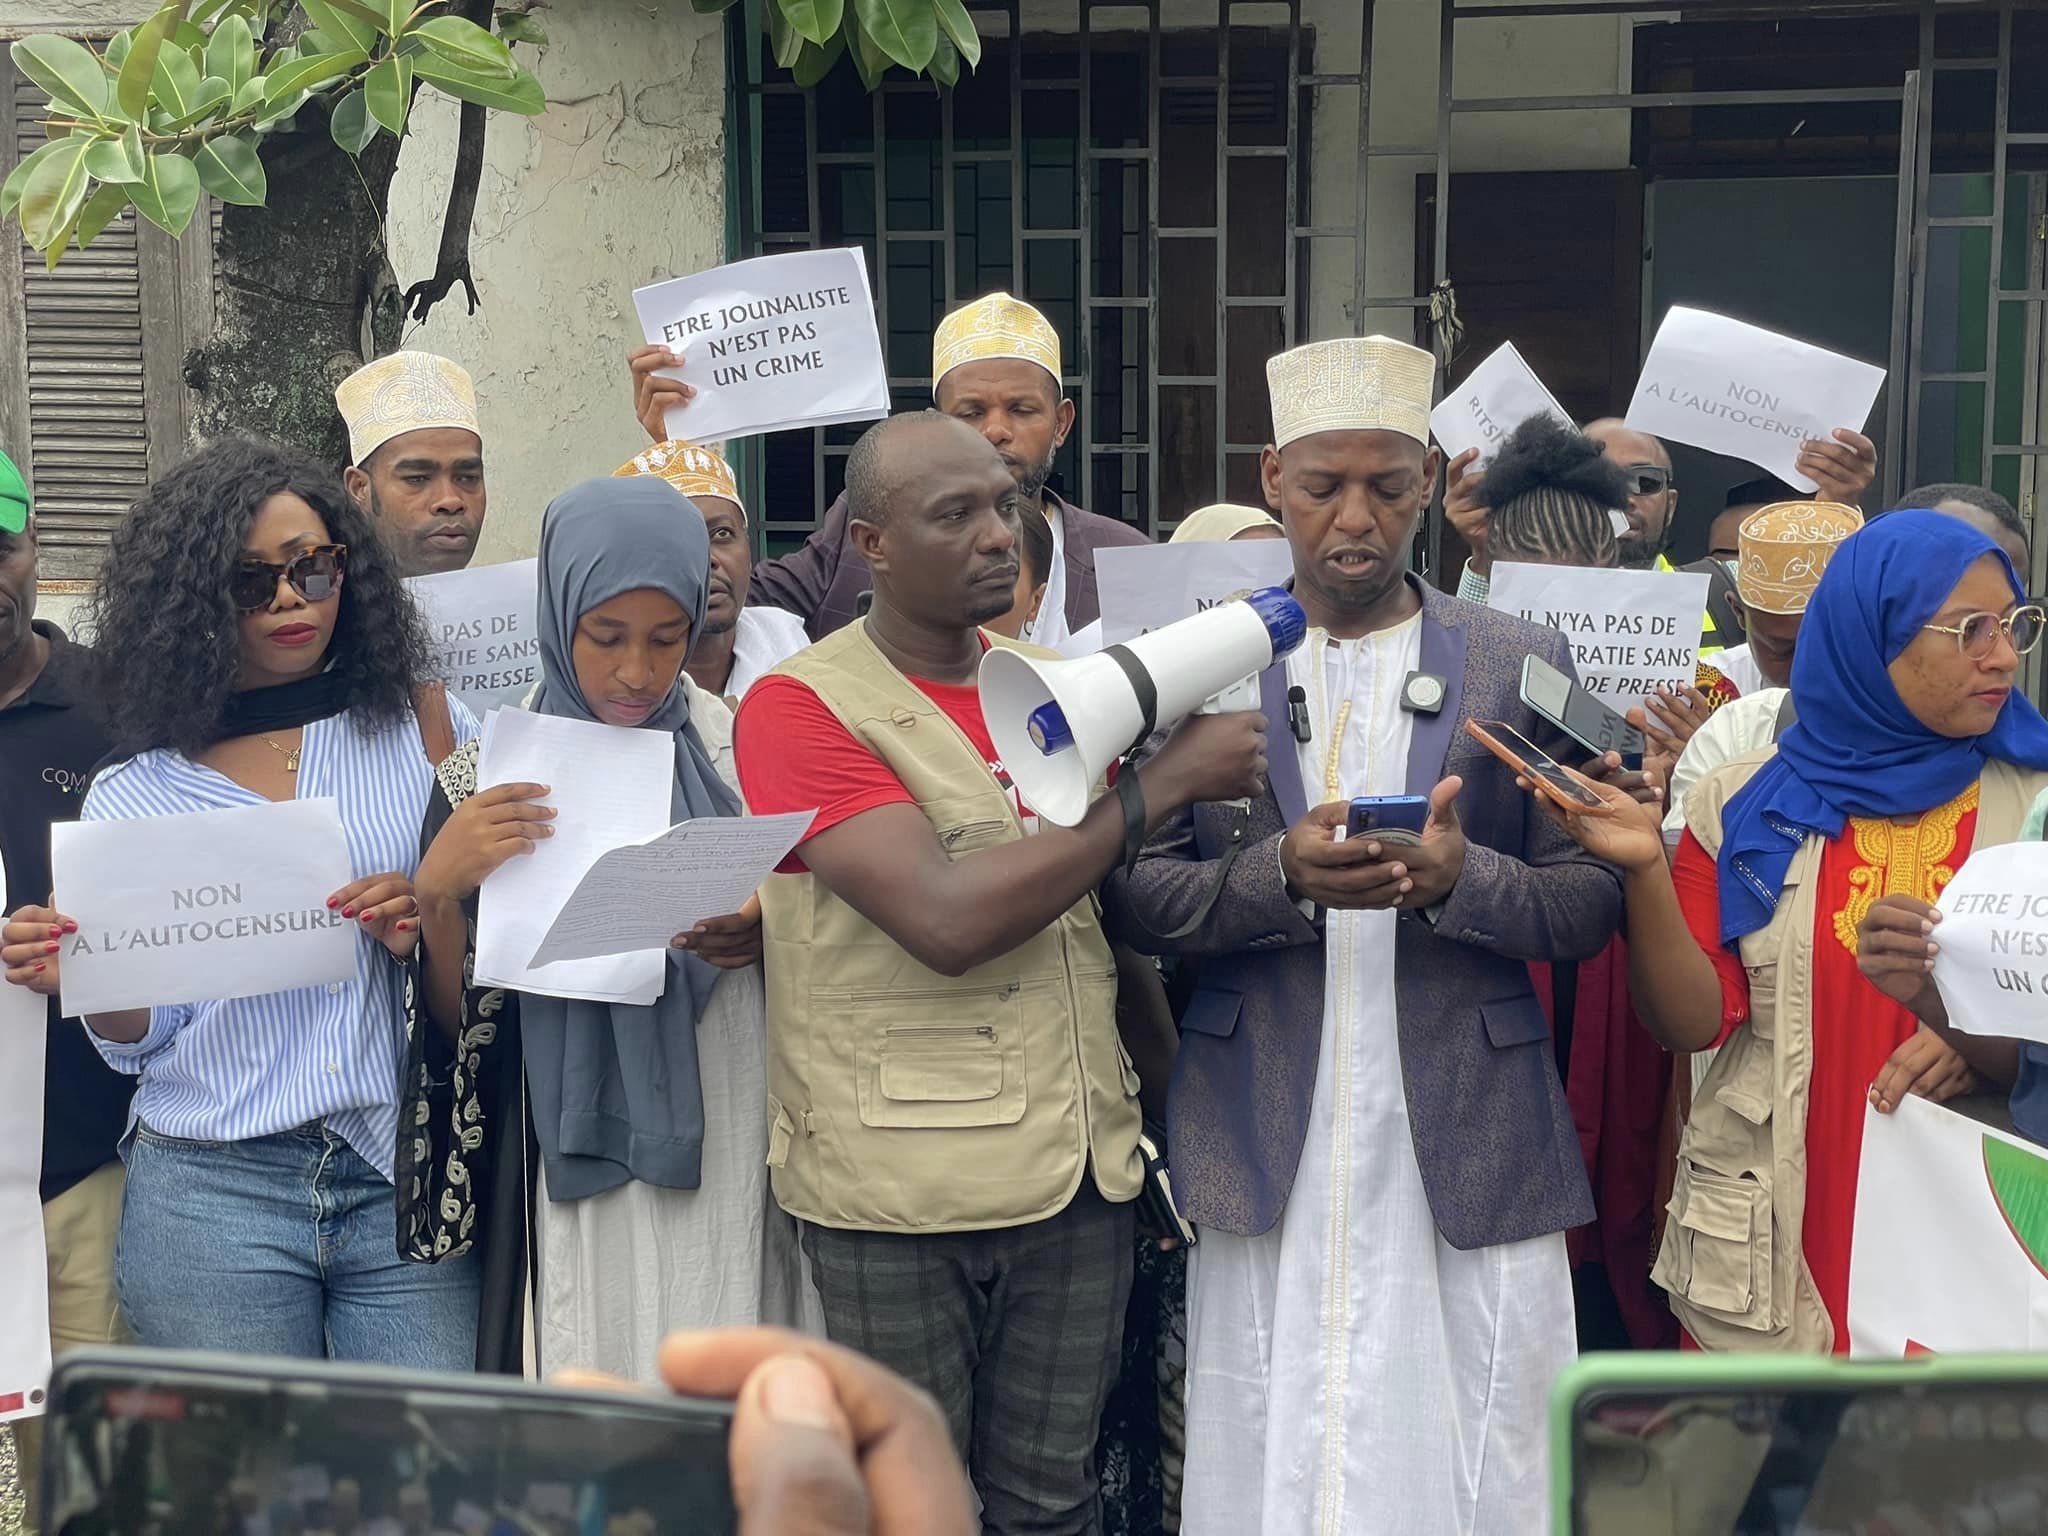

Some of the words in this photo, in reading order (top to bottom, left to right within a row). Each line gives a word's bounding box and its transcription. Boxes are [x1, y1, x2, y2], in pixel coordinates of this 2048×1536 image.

[662, 312, 713, 343] ETRE
[719, 286, 851, 330] JOUNALISTE
[708, 329, 770, 359] N'EST
[777, 321, 817, 345] PAS
[713, 364, 748, 386] UN
[755, 350, 824, 378] CRIME
[1645, 382, 1661, 395] A
[1727, 381, 1781, 412] NON
[442, 619, 483, 643] PAS
[490, 613, 519, 635] DE
[1604, 614, 1643, 635] PAS
[1650, 616, 1677, 636] DE
[486, 637, 540, 664] SANS
[1642, 647, 1692, 667] SANS
[460, 666, 536, 692] PRESSE
[1583, 676, 1611, 693] DE
[171, 883, 243, 911] NON
[1952, 893, 2013, 915] ETRE
[70, 935, 94, 957] A
[103, 907, 344, 953] L'AUTOCENSURE
[1992, 967, 2033, 994] UN
